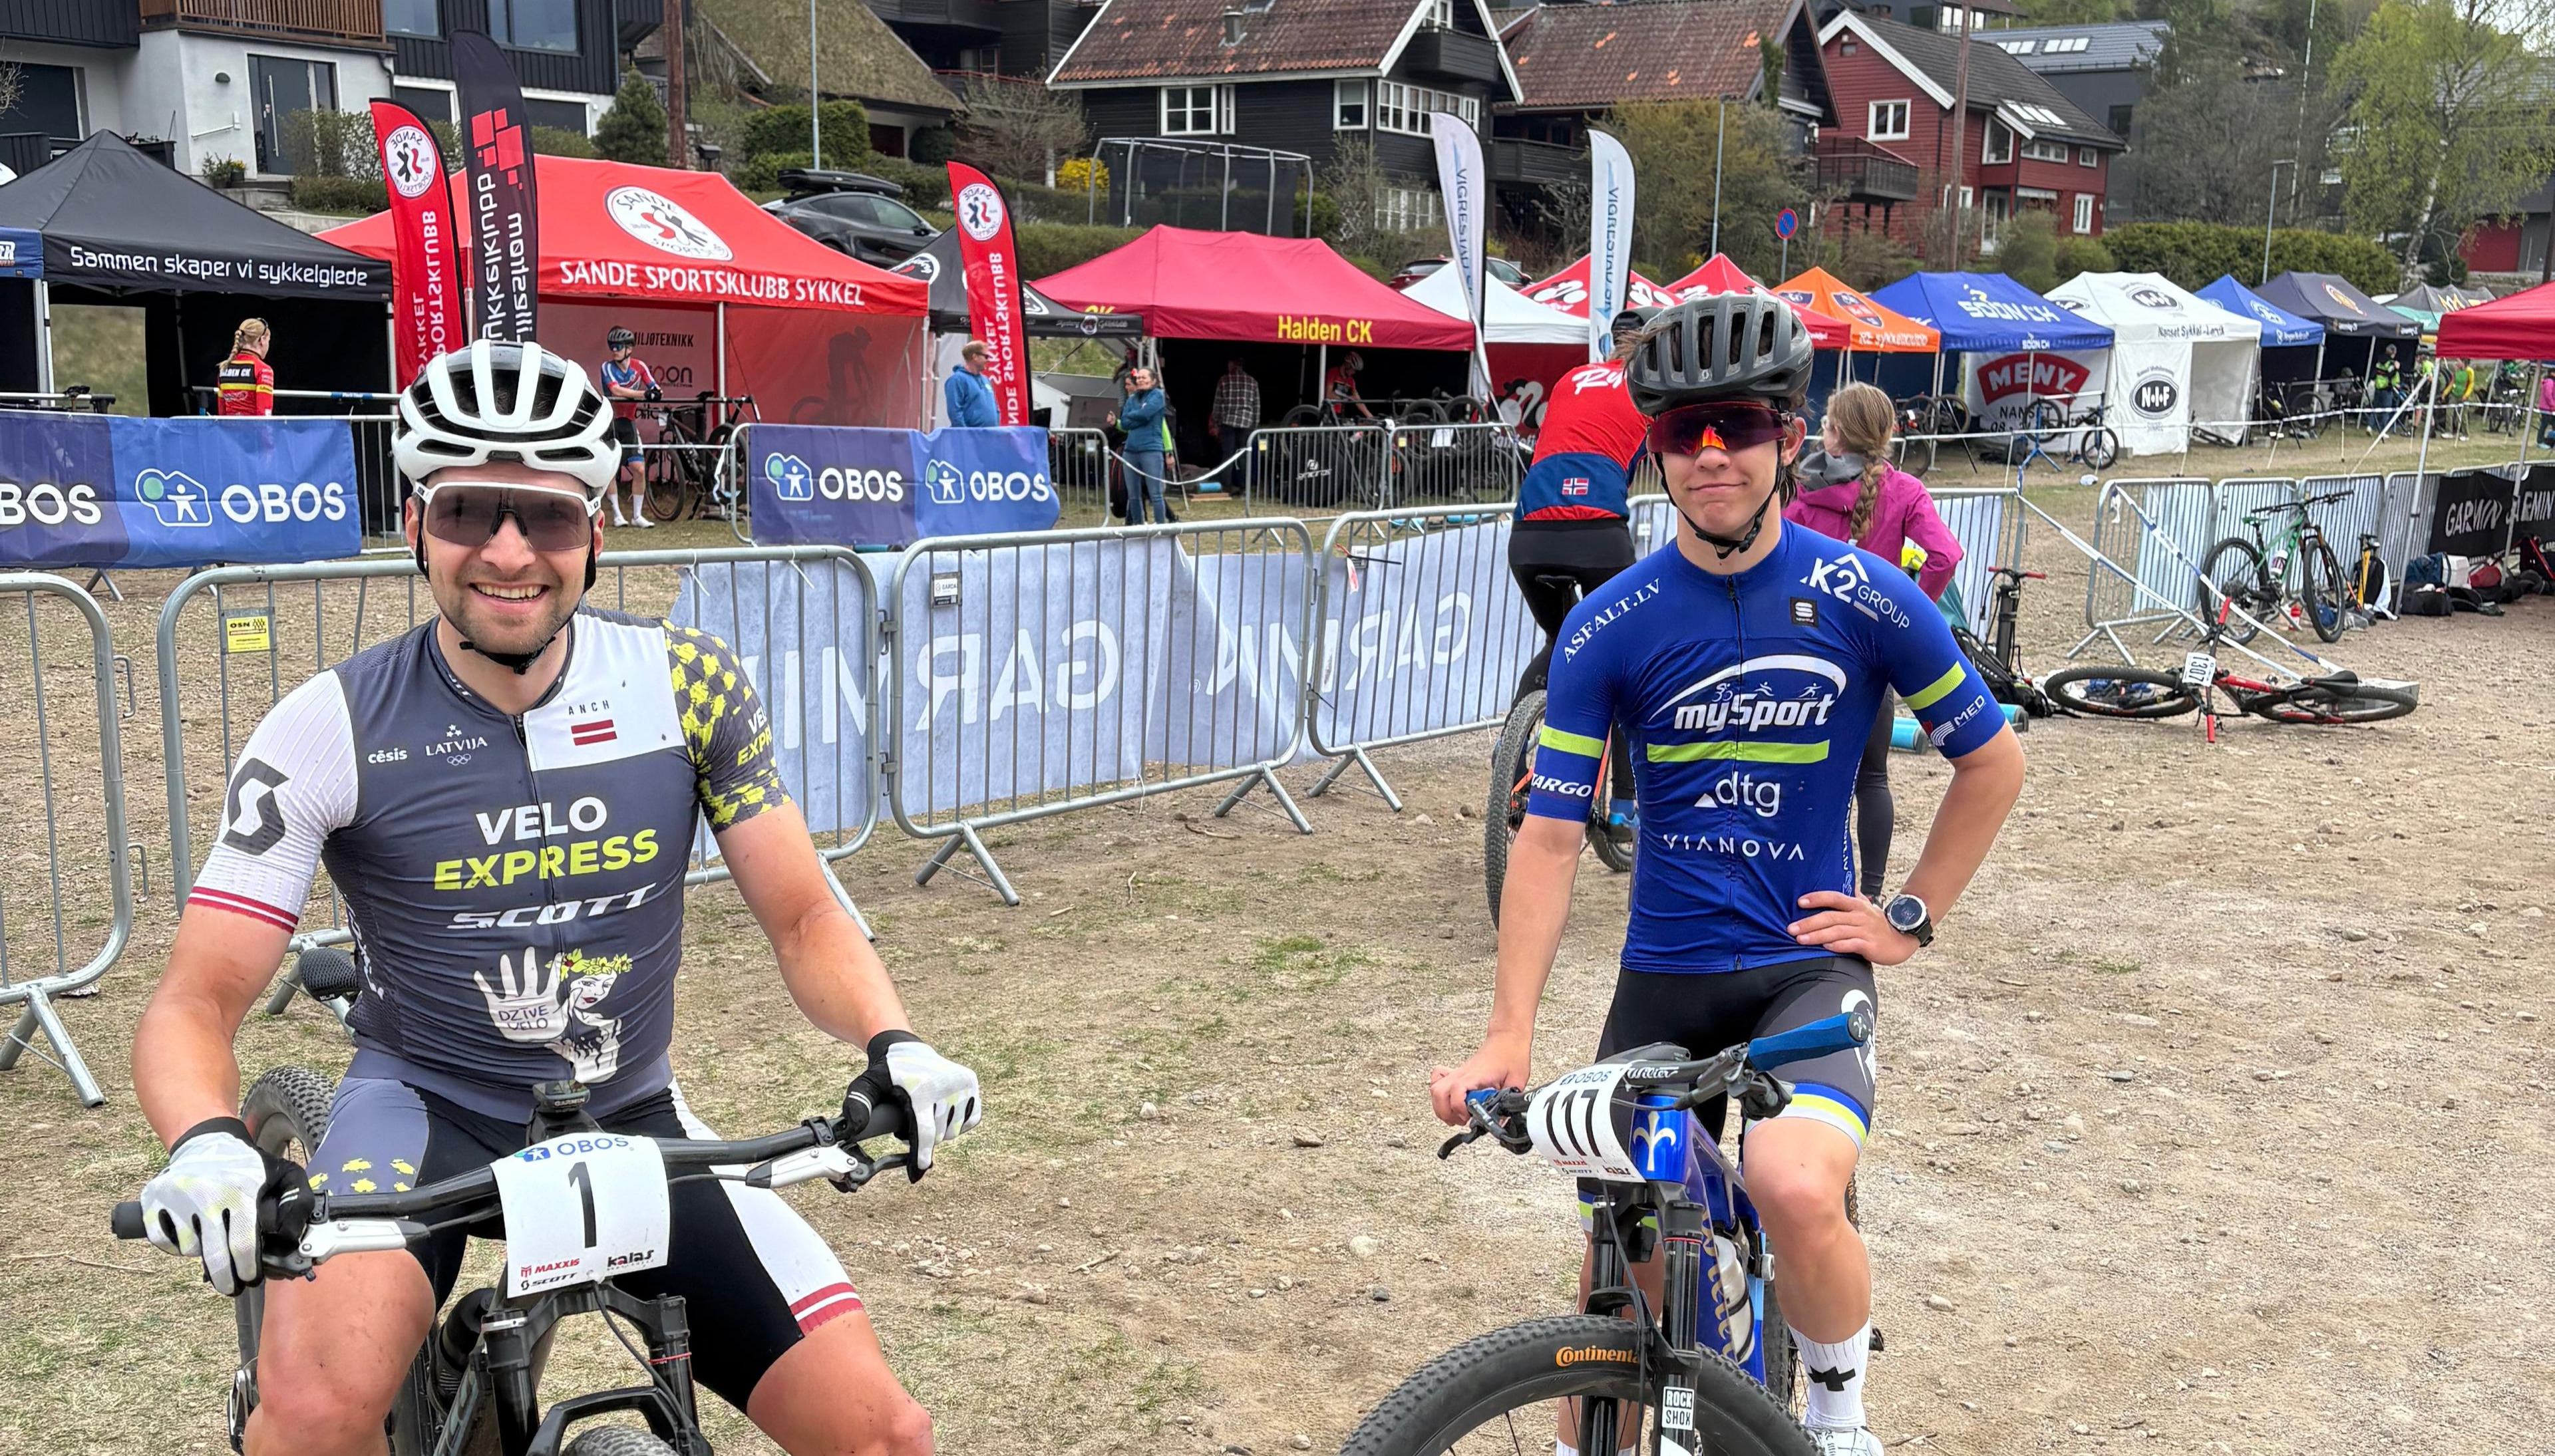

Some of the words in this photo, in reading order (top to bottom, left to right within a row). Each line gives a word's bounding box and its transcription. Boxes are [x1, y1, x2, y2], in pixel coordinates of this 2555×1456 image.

[71, 246, 158, 272] Sammen
[164, 254, 231, 280] skaper
[236, 259, 253, 279] vi
[259, 263, 368, 288] sykkelglede
[560, 260, 640, 288] SANDE
[645, 266, 790, 301] SPORTSKLUBB
[794, 278, 865, 306] SYKKEL
[1958, 301, 2029, 321] SOON
[1278, 315, 1341, 342] Halden
[1347, 319, 1373, 343] CK
[1988, 361, 2077, 392] MENY
[1999, 406, 2054, 420] NANST
[819, 467, 904, 502] OBOS
[969, 471, 1049, 502] OBOS
[220, 482, 346, 523] OBOS
[1809, 557, 1857, 603] K2
[1857, 585, 1910, 629] GROUP
[1564, 578, 1661, 664] ASFALT.LV
[2188, 656, 2209, 682] 1307
[1674, 693, 1836, 734] mySport
[1954, 695, 1985, 726] MED
[368, 748, 408, 764] cēsis
[425, 736, 488, 757] LATVIJA
[1715, 771, 1781, 817] dtg
[476, 796, 607, 845] VELO
[434, 829, 659, 891] EXPRESS
[1663, 834, 1804, 861] VIANOVA
[446, 882, 657, 930] SCOTT
[508, 1018, 548, 1031] VELO
[1575, 1071, 1612, 1084] OBOS
[554, 1097, 586, 1107] GARMIN
[1543, 1088, 1602, 1157] 117
[557, 1136, 629, 1156] OBOS
[568, 1161, 597, 1248] 1
[534, 1258, 580, 1274] MAXXIS
[607, 1249, 655, 1268] kalas
[531, 1272, 578, 1287] SCOTT
[1665, 1389, 1693, 1408] ROCK
[1665, 1409, 1691, 1425] SHOX
